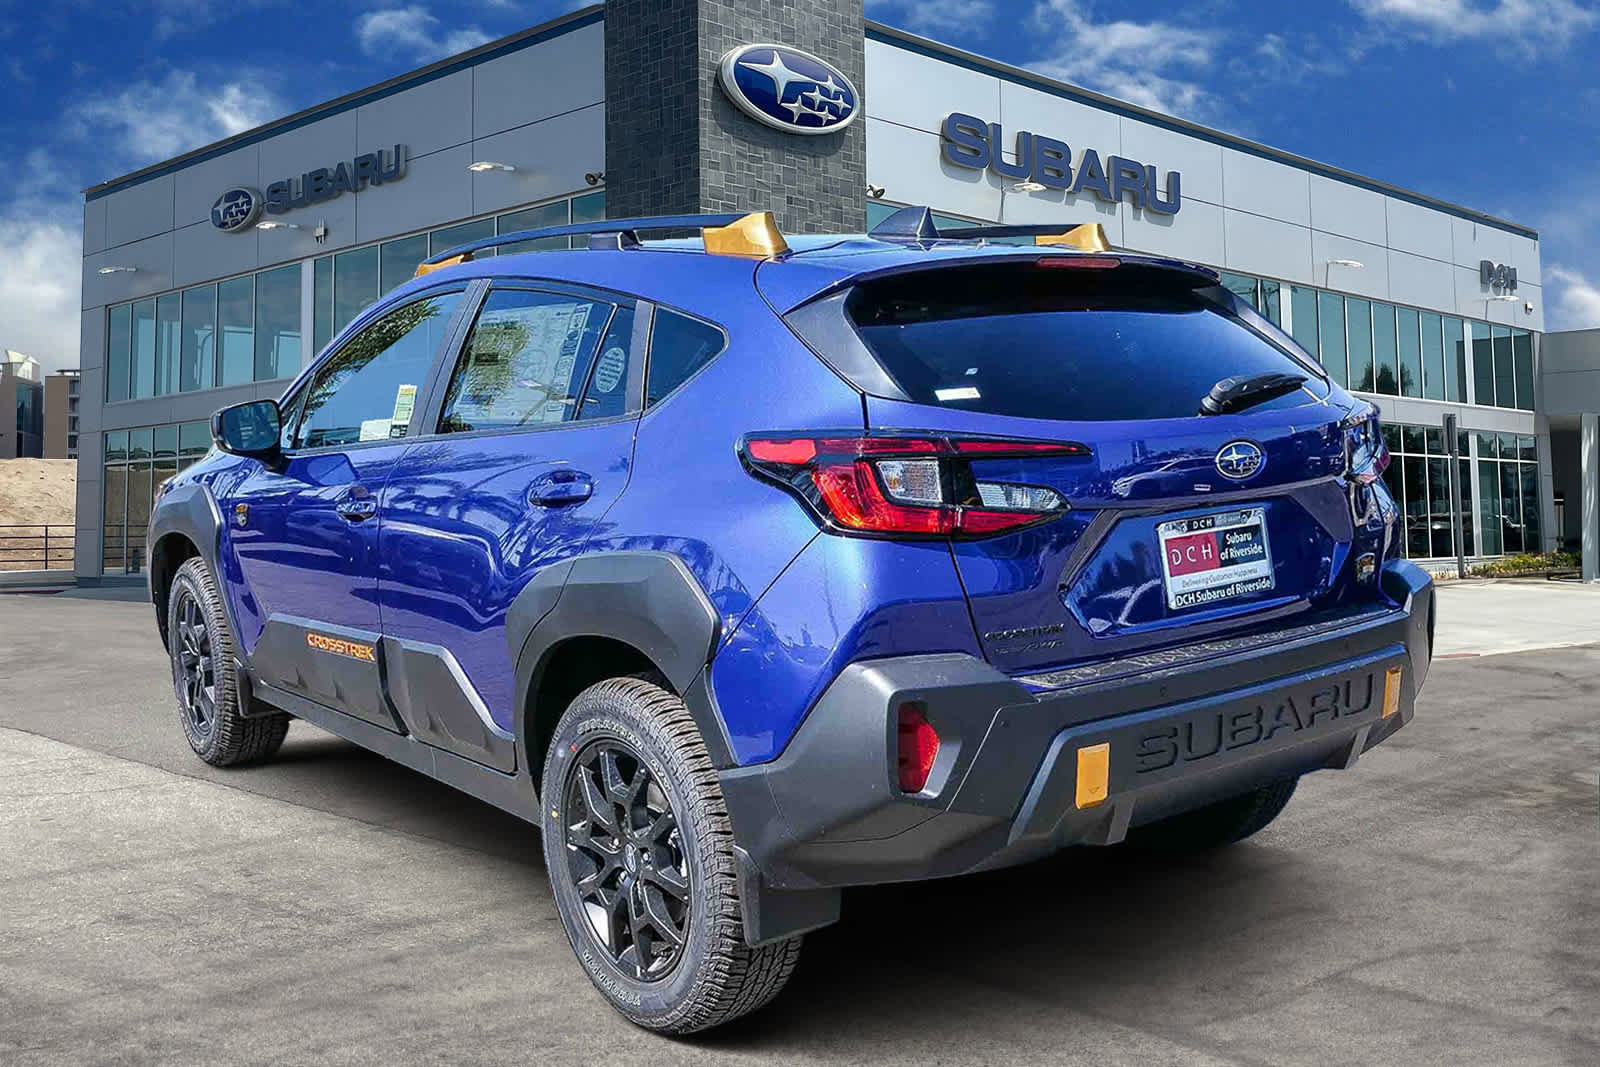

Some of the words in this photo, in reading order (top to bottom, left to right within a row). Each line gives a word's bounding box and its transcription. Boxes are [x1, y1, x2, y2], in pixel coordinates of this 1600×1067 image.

[941, 112, 1181, 215] SUBARU
[266, 144, 407, 214] SUBARU
[1193, 519, 1213, 529] DCH
[1226, 531, 1252, 544] Subaru
[1171, 543, 1213, 565] DCH
[1220, 550, 1230, 560] of
[1230, 543, 1263, 559] Riverside
[1176, 592, 1196, 607] DCH
[1196, 587, 1226, 603] Subaru
[1227, 584, 1235, 596] of
[1235, 578, 1271, 594] Riverside
[307, 633, 376, 661] CROSSTREK
[1136, 674, 1374, 774] SUBARU
